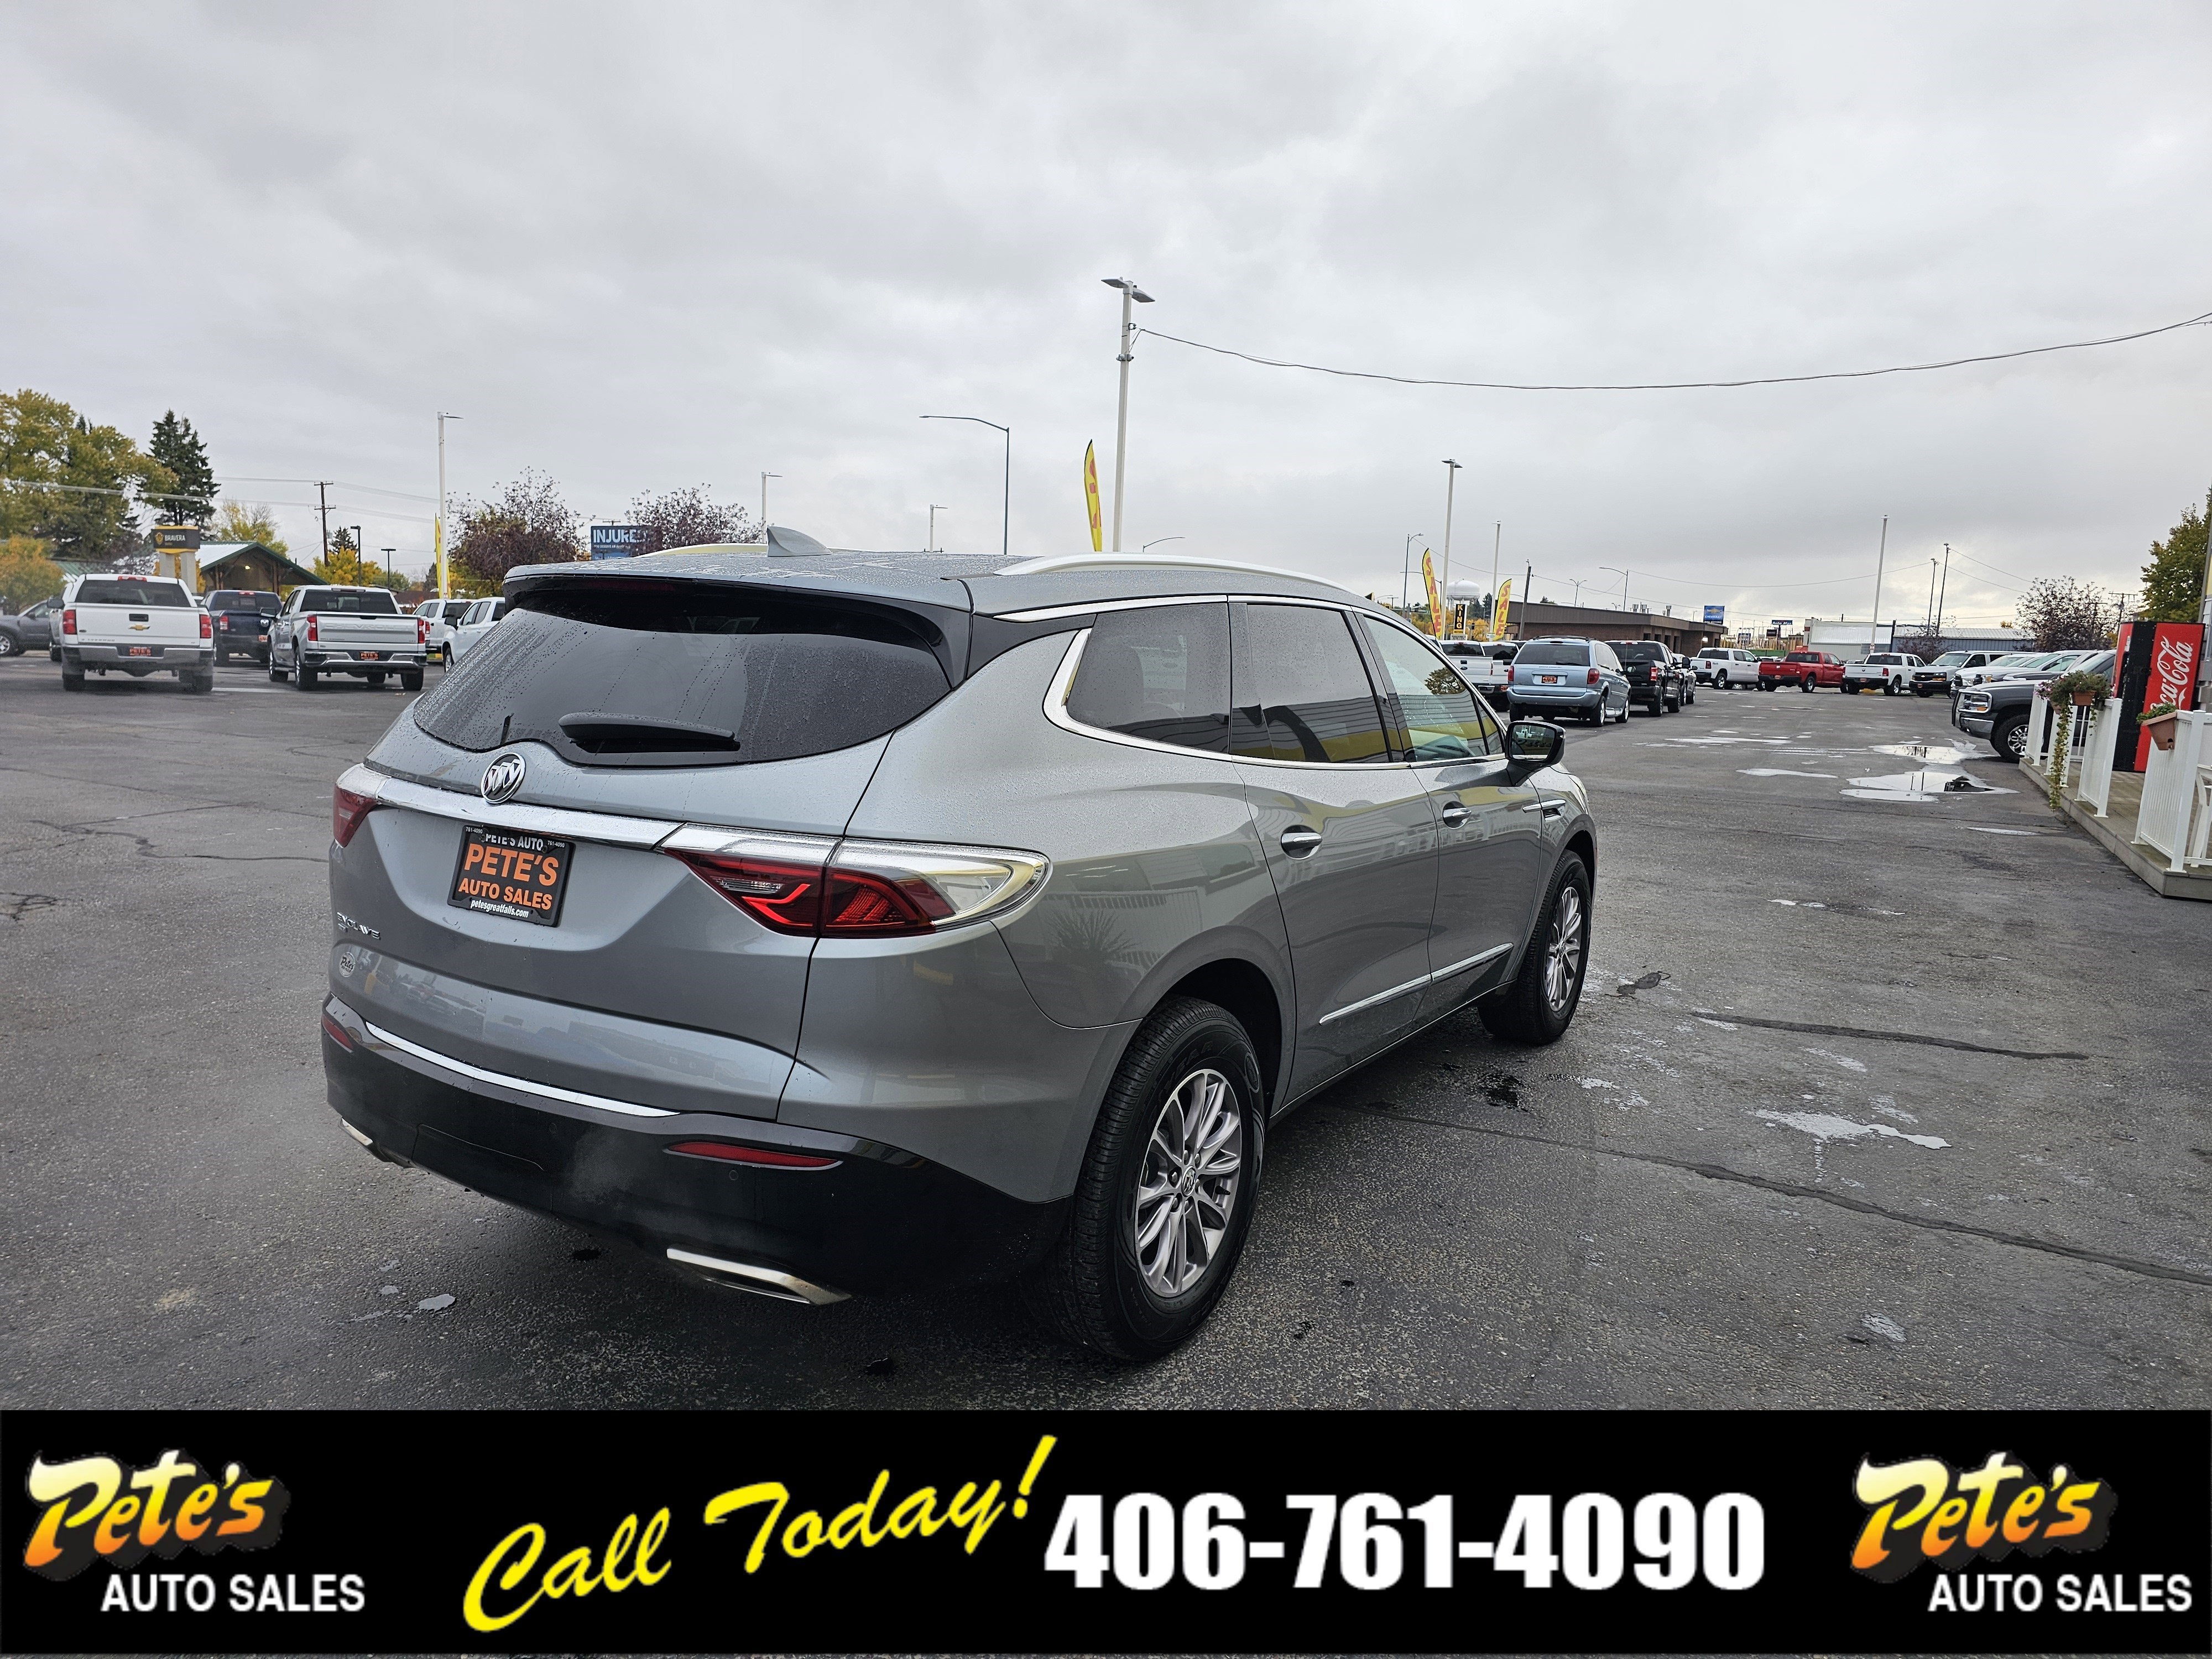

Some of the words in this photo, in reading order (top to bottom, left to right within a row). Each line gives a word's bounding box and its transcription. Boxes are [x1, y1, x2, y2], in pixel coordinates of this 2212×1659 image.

[1426, 557, 1441, 633] SALE
[1496, 585, 1510, 636] SALE
[2150, 635, 2193, 710] ca-Cola
[517, 836, 544, 851] AUTO
[547, 840, 565, 848] 761-4090
[464, 843, 559, 886] PETE'S
[458, 878, 500, 900] AUTO
[503, 886, 552, 910] SALES
[471, 899, 529, 918] petesgreatfalls.com
